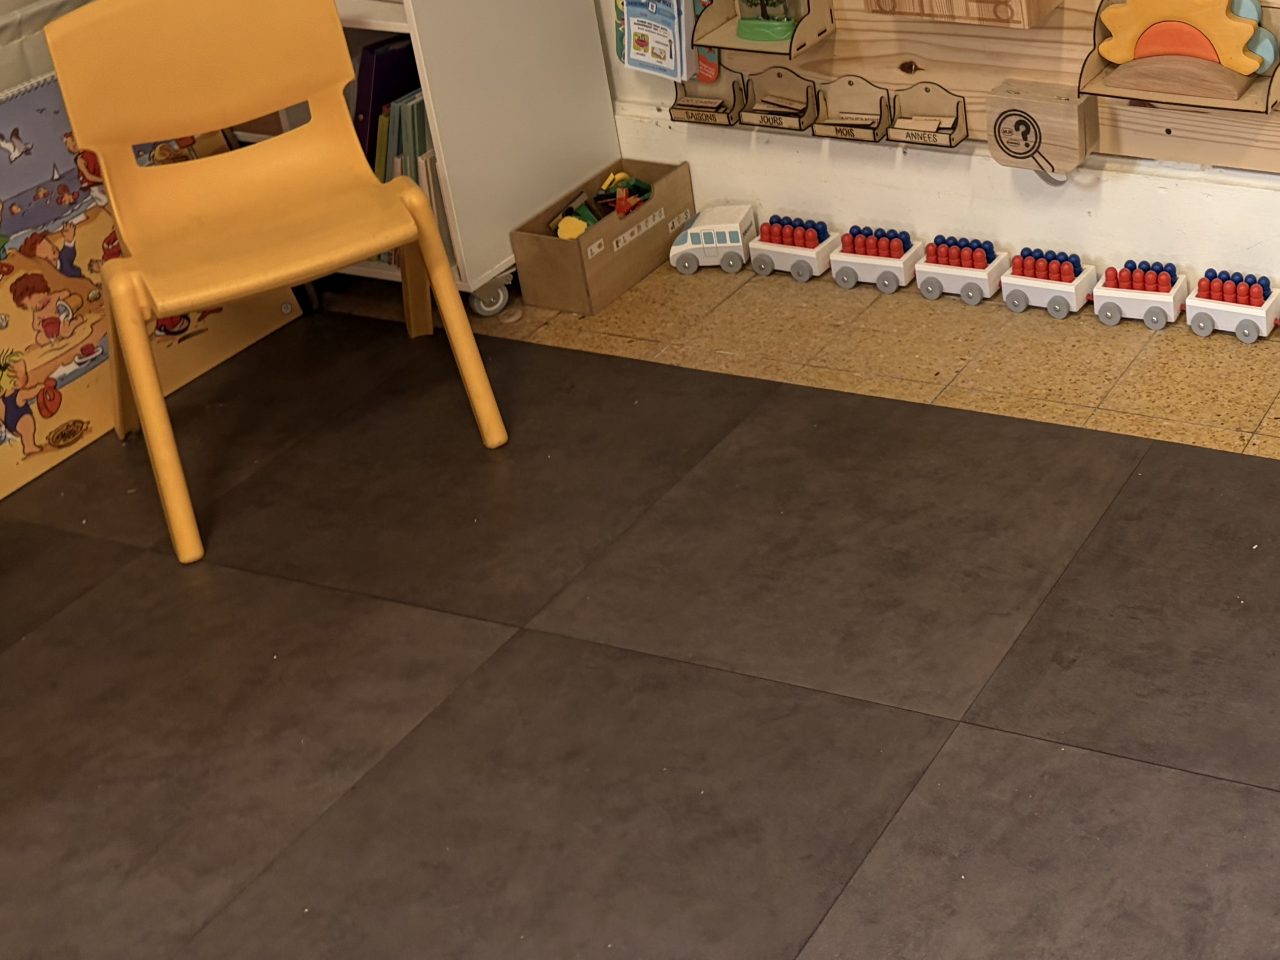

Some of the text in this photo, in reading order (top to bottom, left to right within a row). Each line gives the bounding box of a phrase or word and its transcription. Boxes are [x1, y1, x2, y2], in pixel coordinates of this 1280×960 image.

[685, 111, 717, 123] SAISONS
[759, 115, 784, 126] JOURS
[834, 126, 855, 138] MOIS
